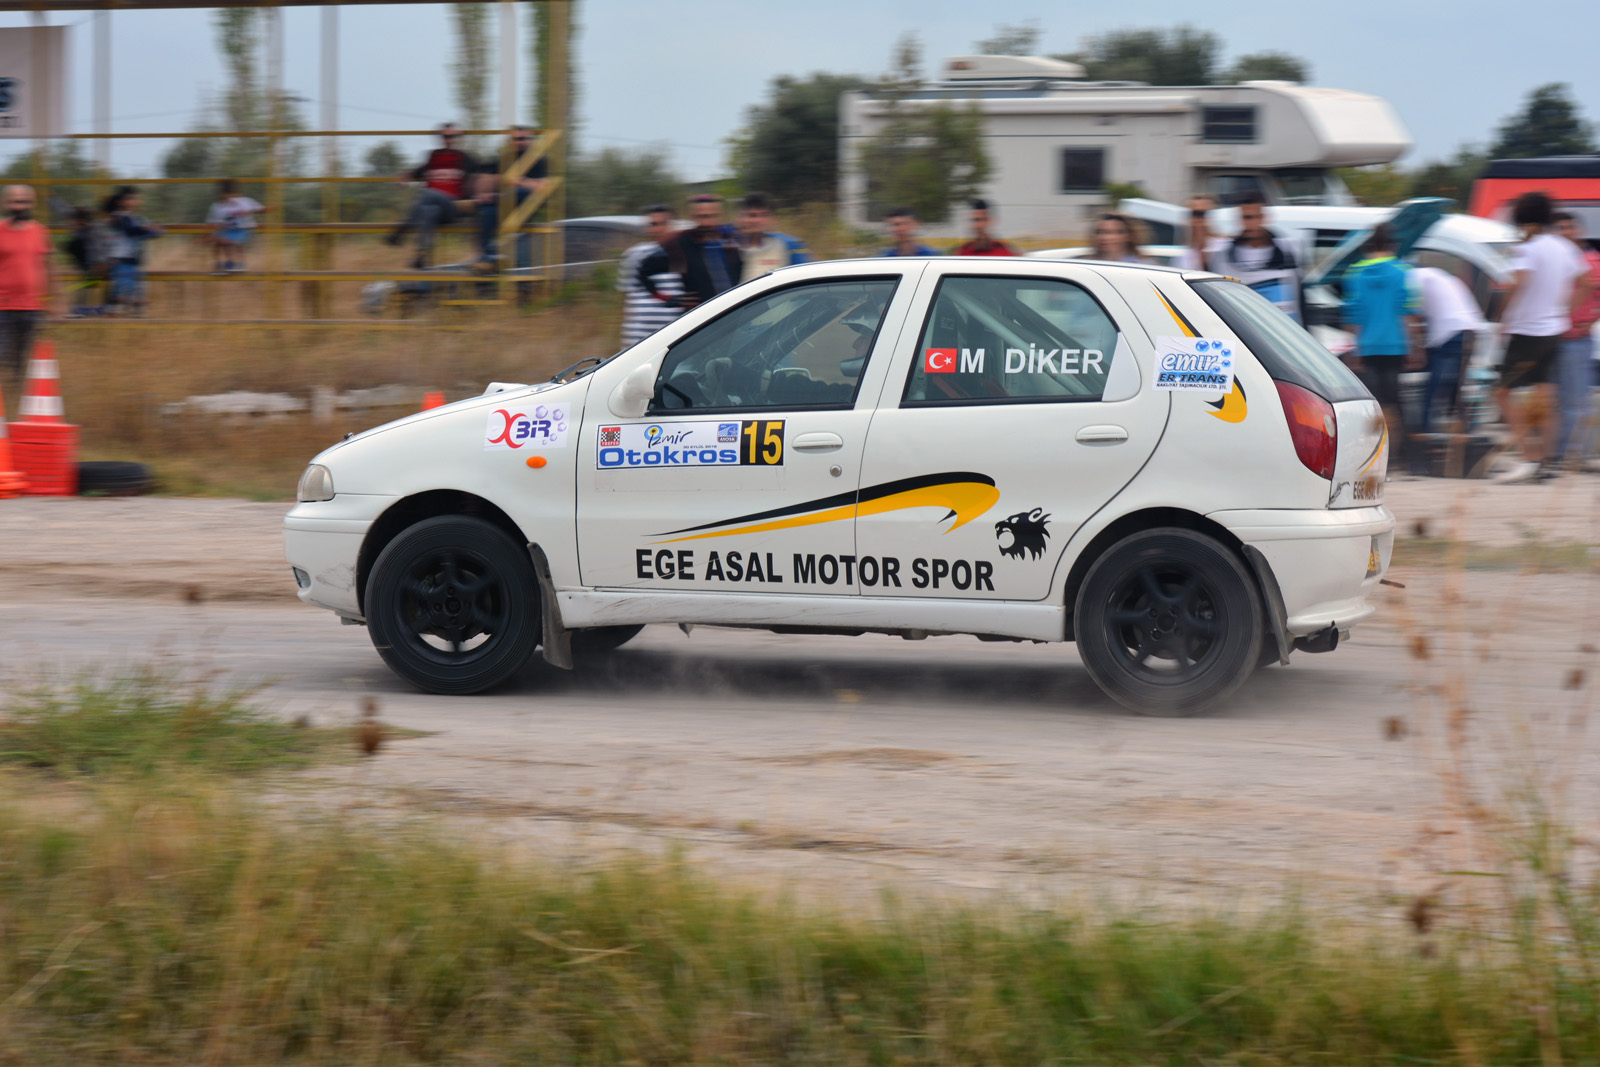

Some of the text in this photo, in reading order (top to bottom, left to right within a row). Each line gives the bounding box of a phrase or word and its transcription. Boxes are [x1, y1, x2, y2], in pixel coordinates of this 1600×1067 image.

[960, 343, 1104, 374] M DİKER
[1159, 373, 1228, 384] ER TRANS
[600, 446, 737, 466] Otokros
[744, 421, 783, 465] 15
[636, 549, 995, 591] EGE ASAL MOTOR SPOR
